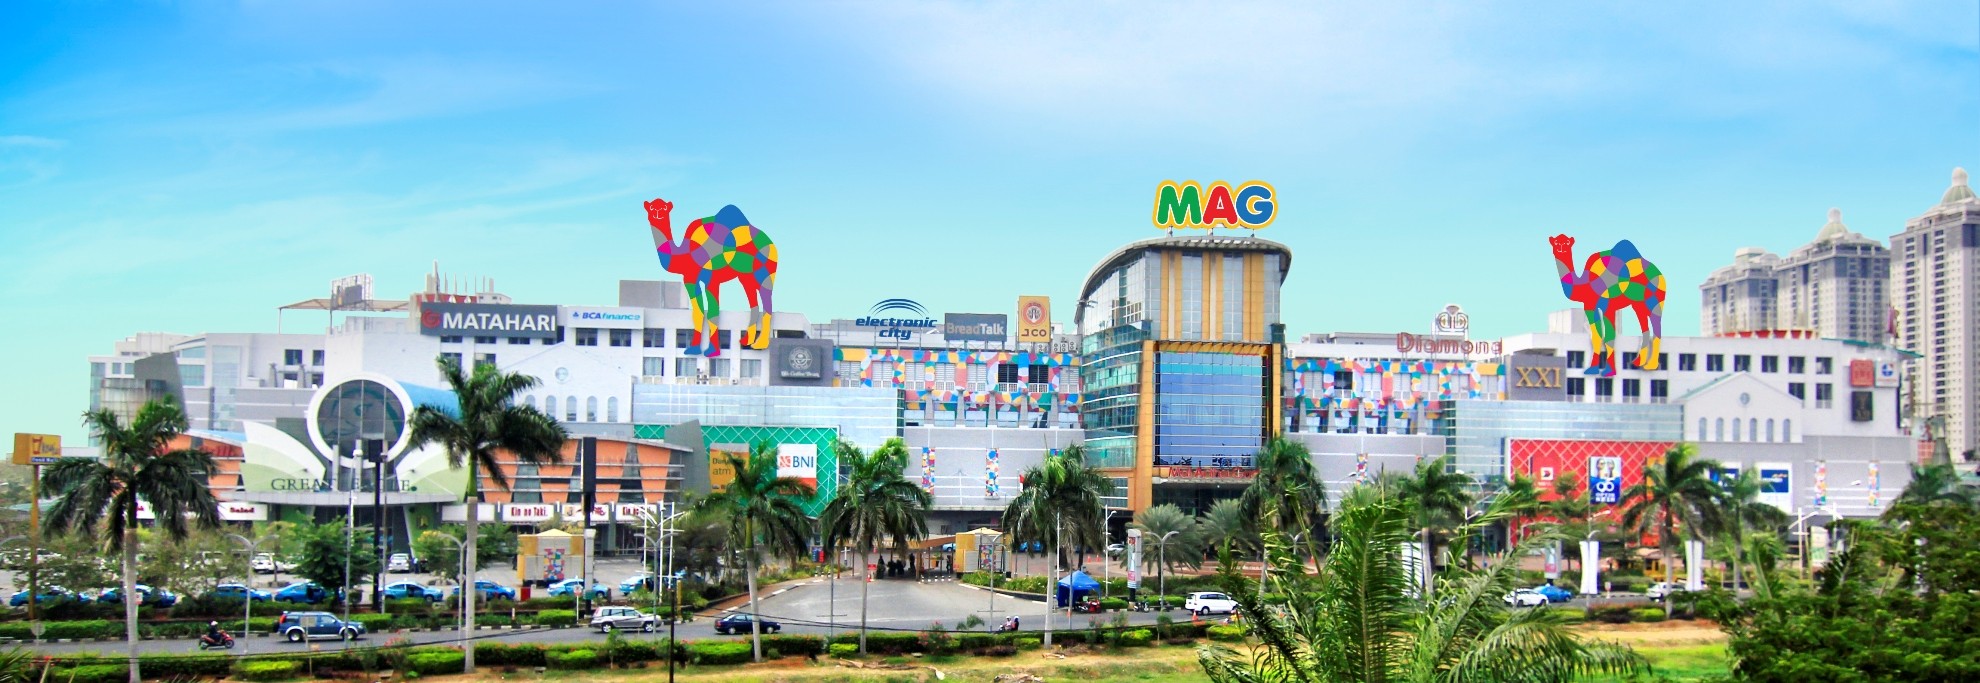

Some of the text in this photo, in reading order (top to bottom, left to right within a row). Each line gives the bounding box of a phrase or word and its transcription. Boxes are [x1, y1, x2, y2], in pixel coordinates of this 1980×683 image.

[1155, 183, 1275, 227] MAG
[443, 312, 556, 332] MATAHARI
[856, 316, 937, 328] electronic
[946, 322, 1004, 336] BreadTalk
[879, 327, 911, 340] city
[1396, 332, 1503, 354] Diamond
[1516, 366, 1562, 388] XXI
[793, 456, 814, 468] BNI
